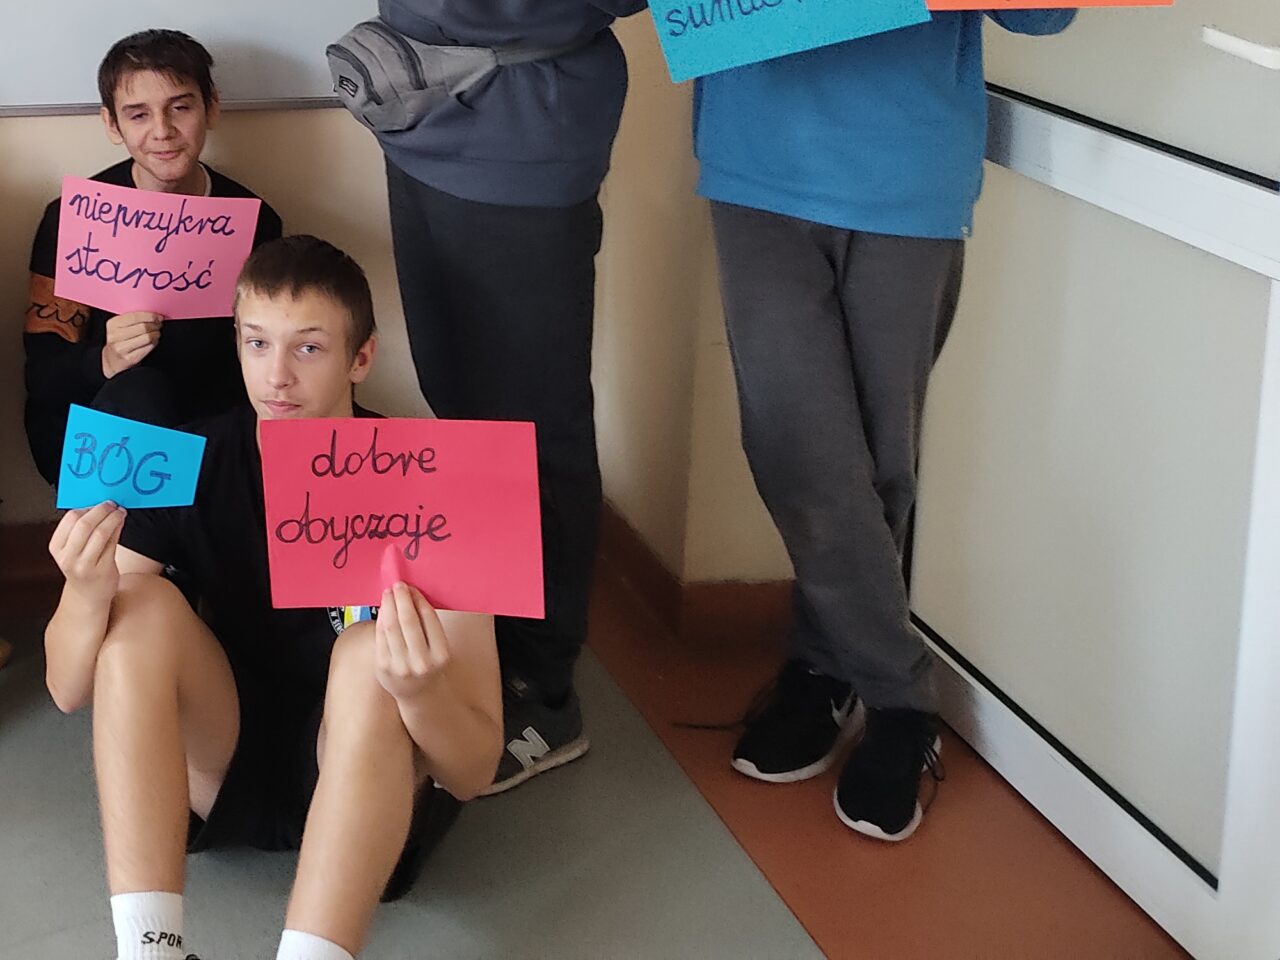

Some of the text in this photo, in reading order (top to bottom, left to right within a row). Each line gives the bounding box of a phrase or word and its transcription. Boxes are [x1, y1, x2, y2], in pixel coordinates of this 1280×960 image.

[69, 190, 235, 256] nieprzykra
[65, 232, 212, 292] starość
[67, 433, 172, 496] BÓG
[311, 427, 437, 477] dobre
[275, 492, 452, 570] obyczaje
